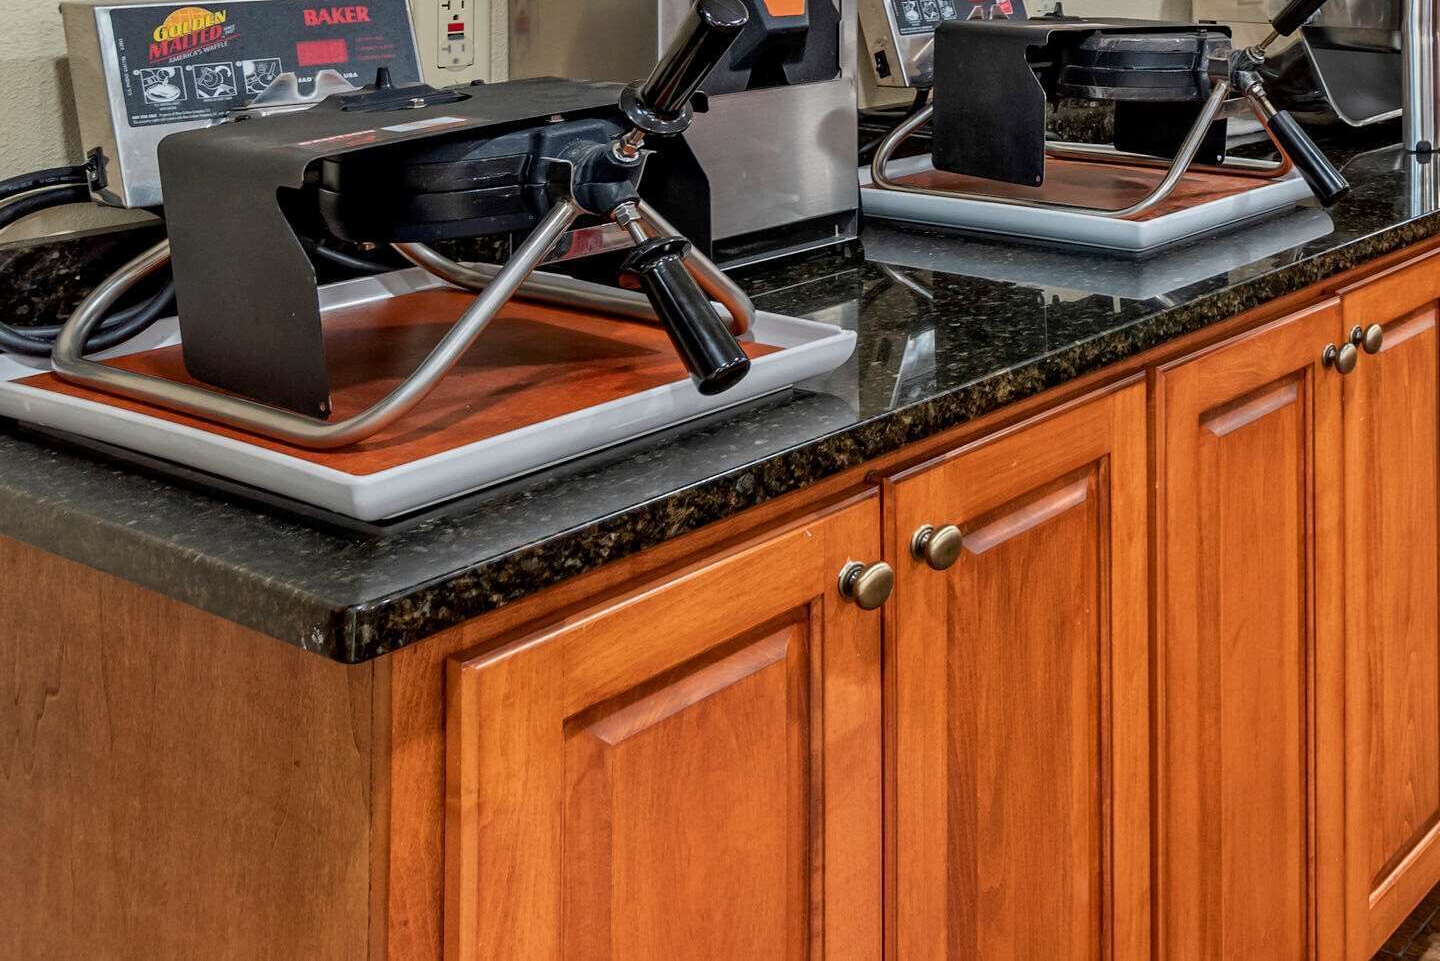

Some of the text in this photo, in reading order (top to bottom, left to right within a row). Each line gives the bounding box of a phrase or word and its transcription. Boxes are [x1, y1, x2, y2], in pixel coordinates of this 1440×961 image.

[153, 9, 227, 43] GOLDEN
[303, 5, 370, 27] BAKER
[148, 24, 223, 61] MALTED
[168, 40, 229, 64] AMERICA'S WAFFLE
